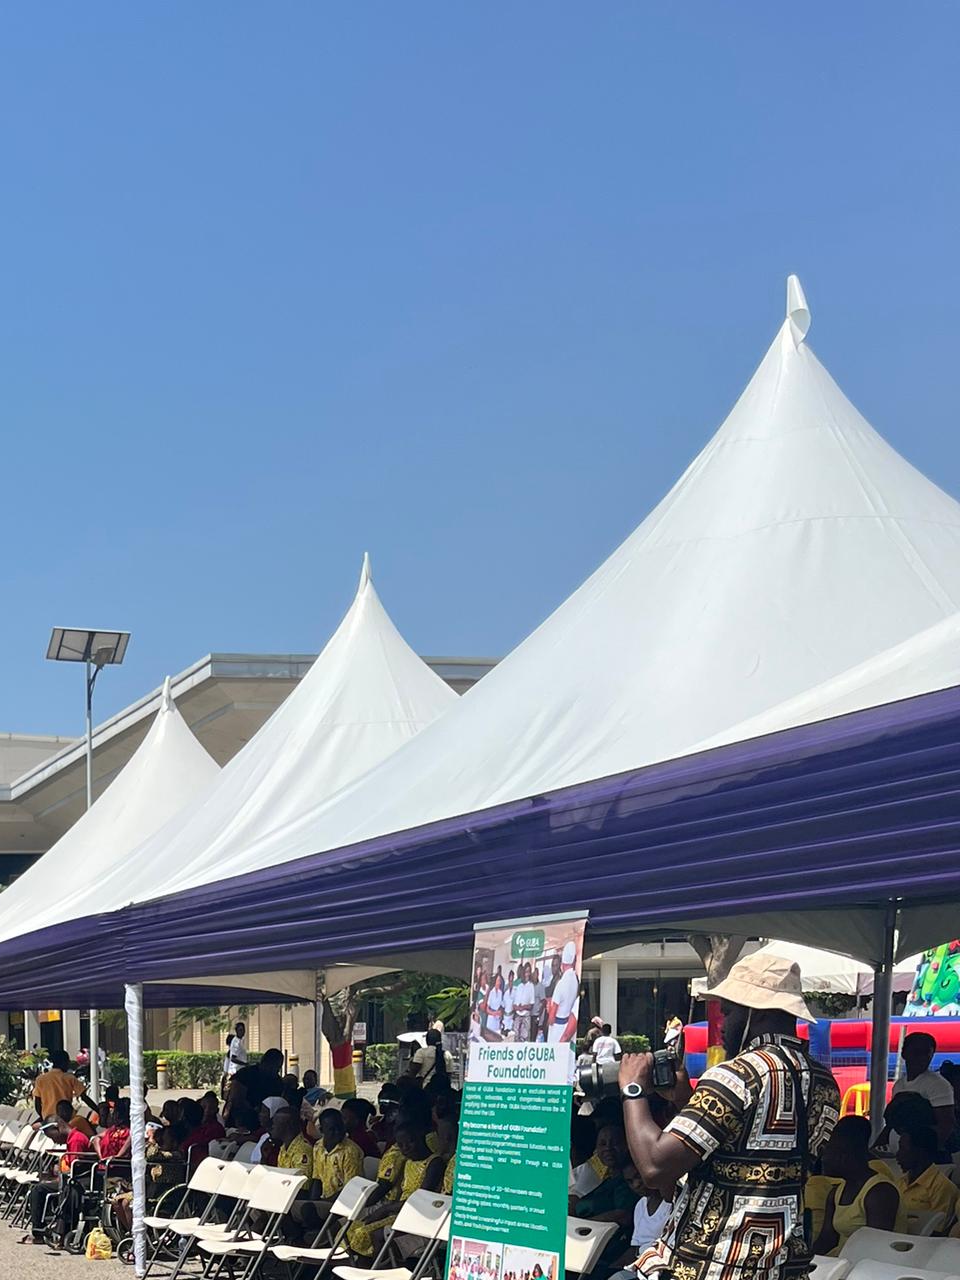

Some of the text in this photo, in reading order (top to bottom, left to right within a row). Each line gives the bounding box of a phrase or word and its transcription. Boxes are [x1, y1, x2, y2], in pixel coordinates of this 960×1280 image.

[479, 1046, 556, 1062] Friends of GUBA
[487, 1064, 546, 1080] Foundation
